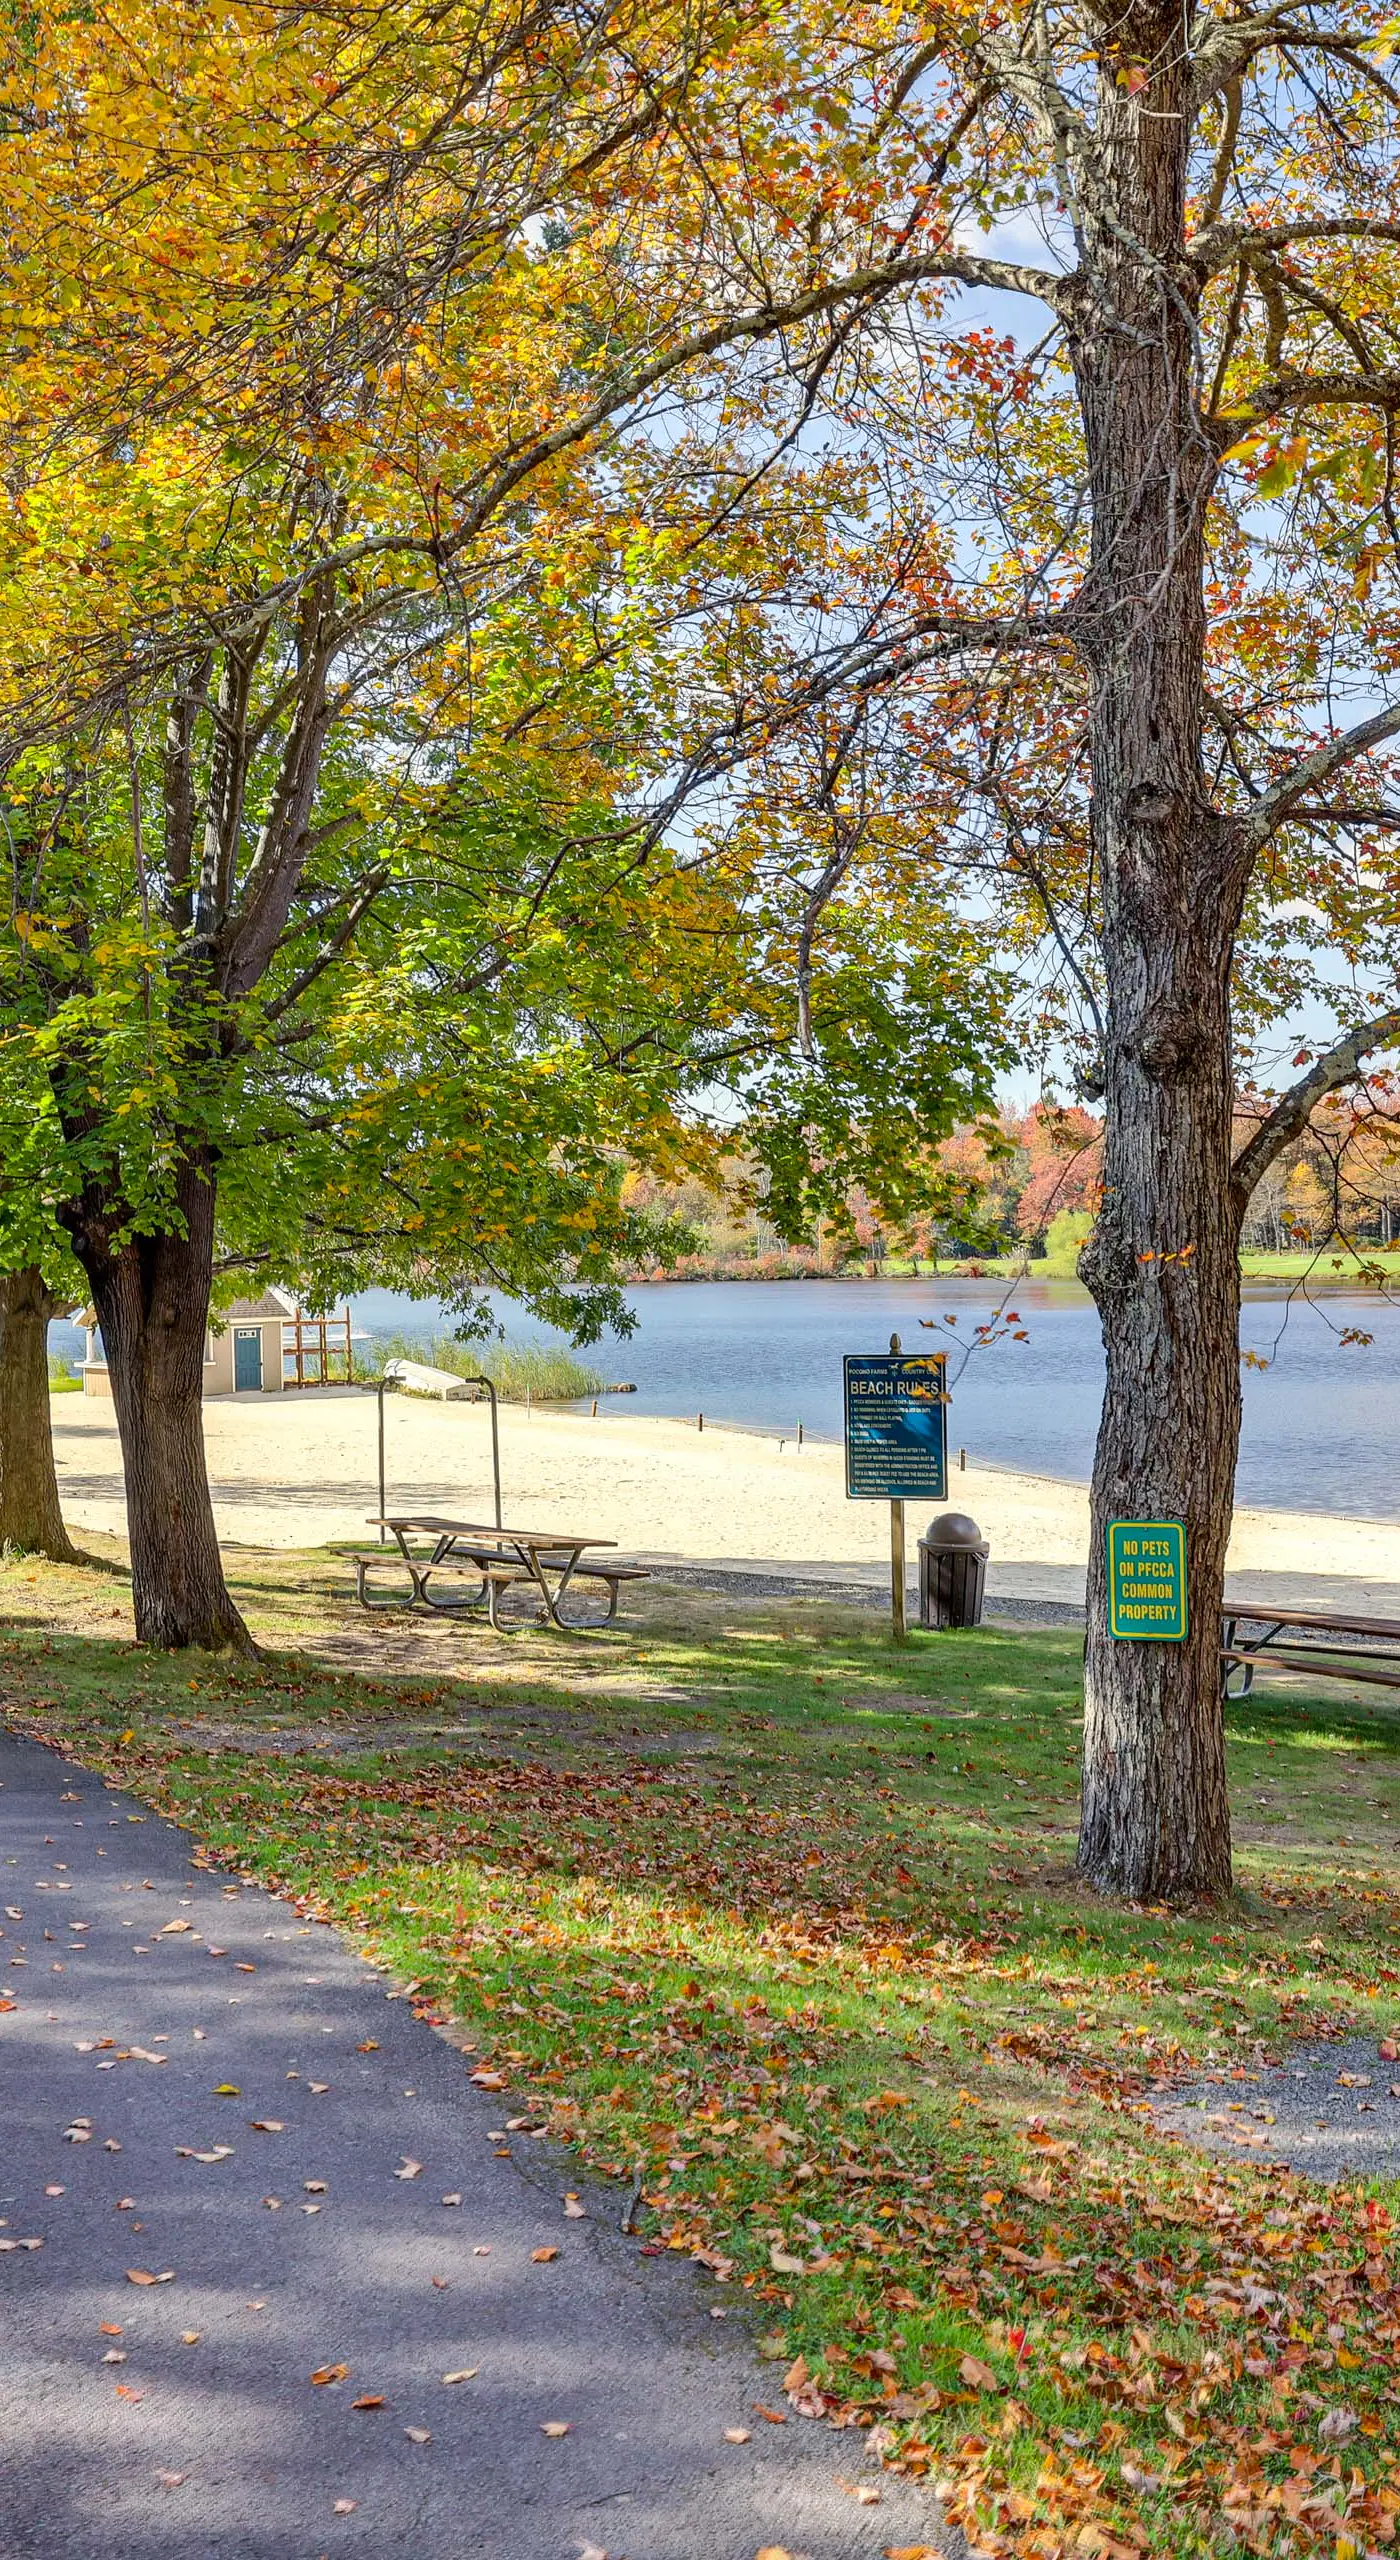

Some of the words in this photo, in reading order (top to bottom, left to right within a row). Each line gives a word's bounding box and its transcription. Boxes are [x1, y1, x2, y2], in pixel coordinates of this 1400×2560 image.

[850, 1381, 894, 1396] BEACH
[1123, 1541, 1138, 1555] NO
[1142, 1541, 1170, 1556] PETS
[1119, 1562, 1134, 1576] ON
[1138, 1562, 1175, 1577] PFCCA
[1122, 1583, 1173, 1599] COMMON
[1118, 1604, 1177, 1620] PROPERTY
